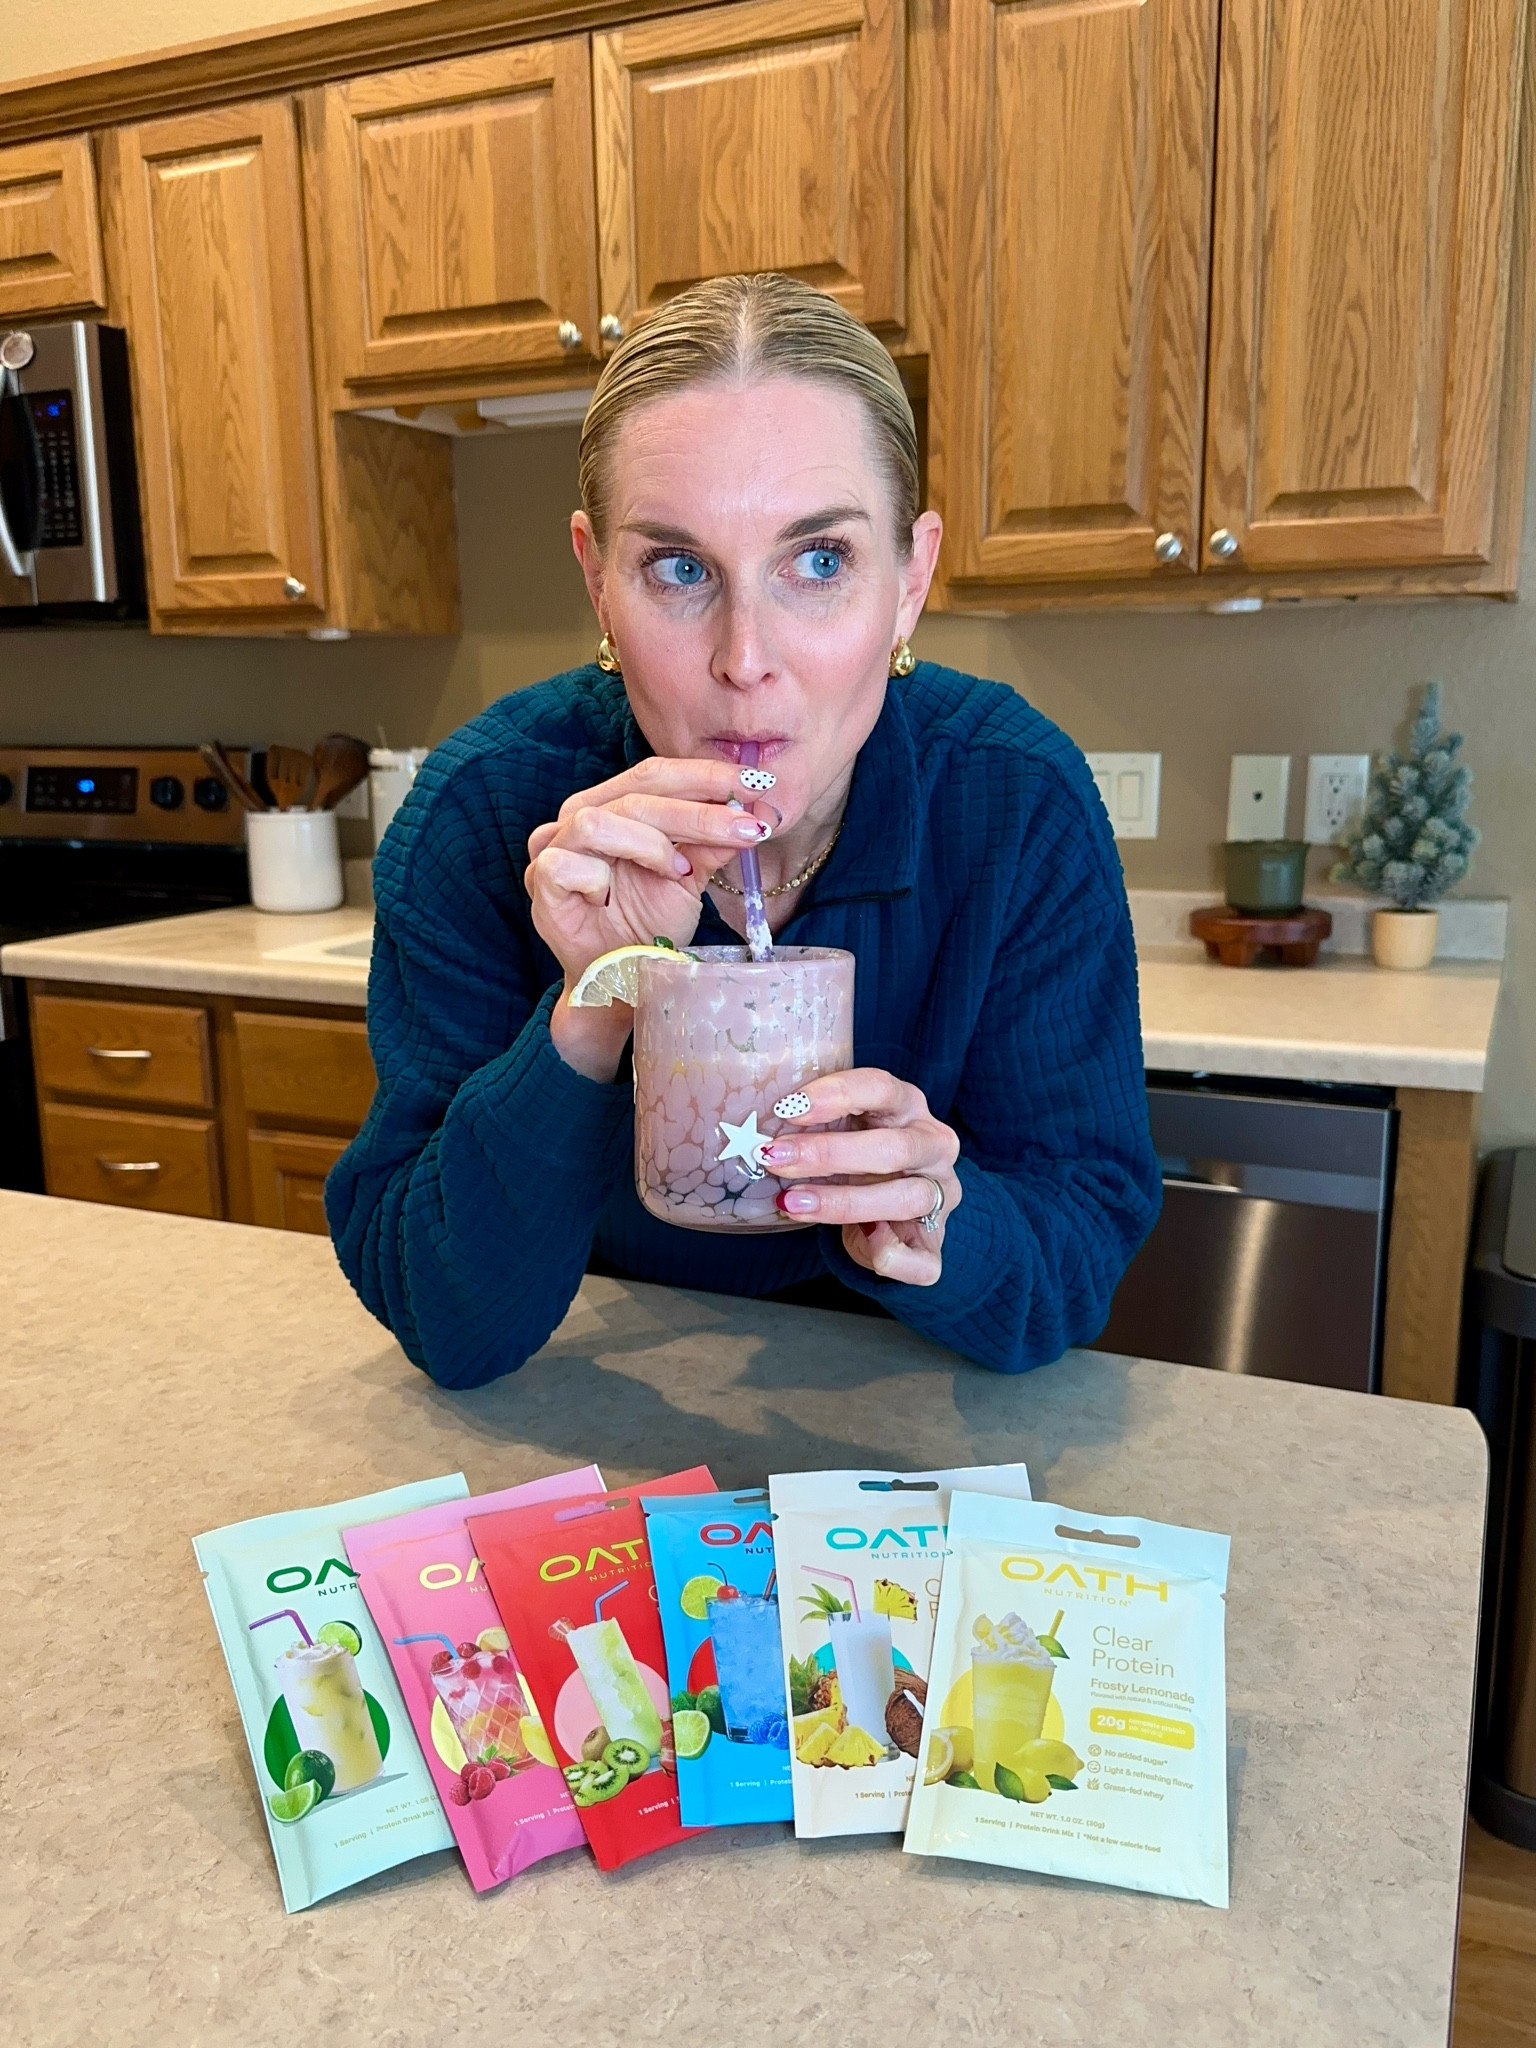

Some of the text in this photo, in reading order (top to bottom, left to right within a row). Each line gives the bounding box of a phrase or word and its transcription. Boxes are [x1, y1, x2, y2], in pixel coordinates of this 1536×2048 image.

[700, 1522, 773, 1546] OA
[825, 1525, 948, 1550] OAT
[539, 1538, 645, 1582] OAT
[588, 1560, 653, 1582] NUTRITIO
[266, 1558, 358, 1594] OA
[1000, 1555, 1168, 1603] OATH
[1092, 1625, 1153, 1652] Clear
[1092, 1648, 1174, 1678] Protein
[1090, 1678, 1195, 1705] Frosty Lemonade
[1096, 1714, 1126, 1731] 20g
[1104, 1749, 1117, 1758] No
[1117, 1752, 1142, 1762] added
[735, 1780, 761, 1788] Serving
[1104, 1765, 1124, 1775] Light
[1132, 1770, 1172, 1785] refreshing
[860, 1791, 885, 1799] Serving
[1103, 1782, 1165, 1801] Grass-fed whey
[643, 1800, 669, 1814] Serving
[1030, 1810, 1044, 1818] NET
[519, 1812, 545, 1825] Serving
[980, 1817, 1006, 1828] Serving
[1015, 1822, 1041, 1832] Protein
[1041, 1826, 1060, 1835] Drink
[1061, 1829, 1075, 1838] Mix
[1144, 1844, 1161, 1853] food
